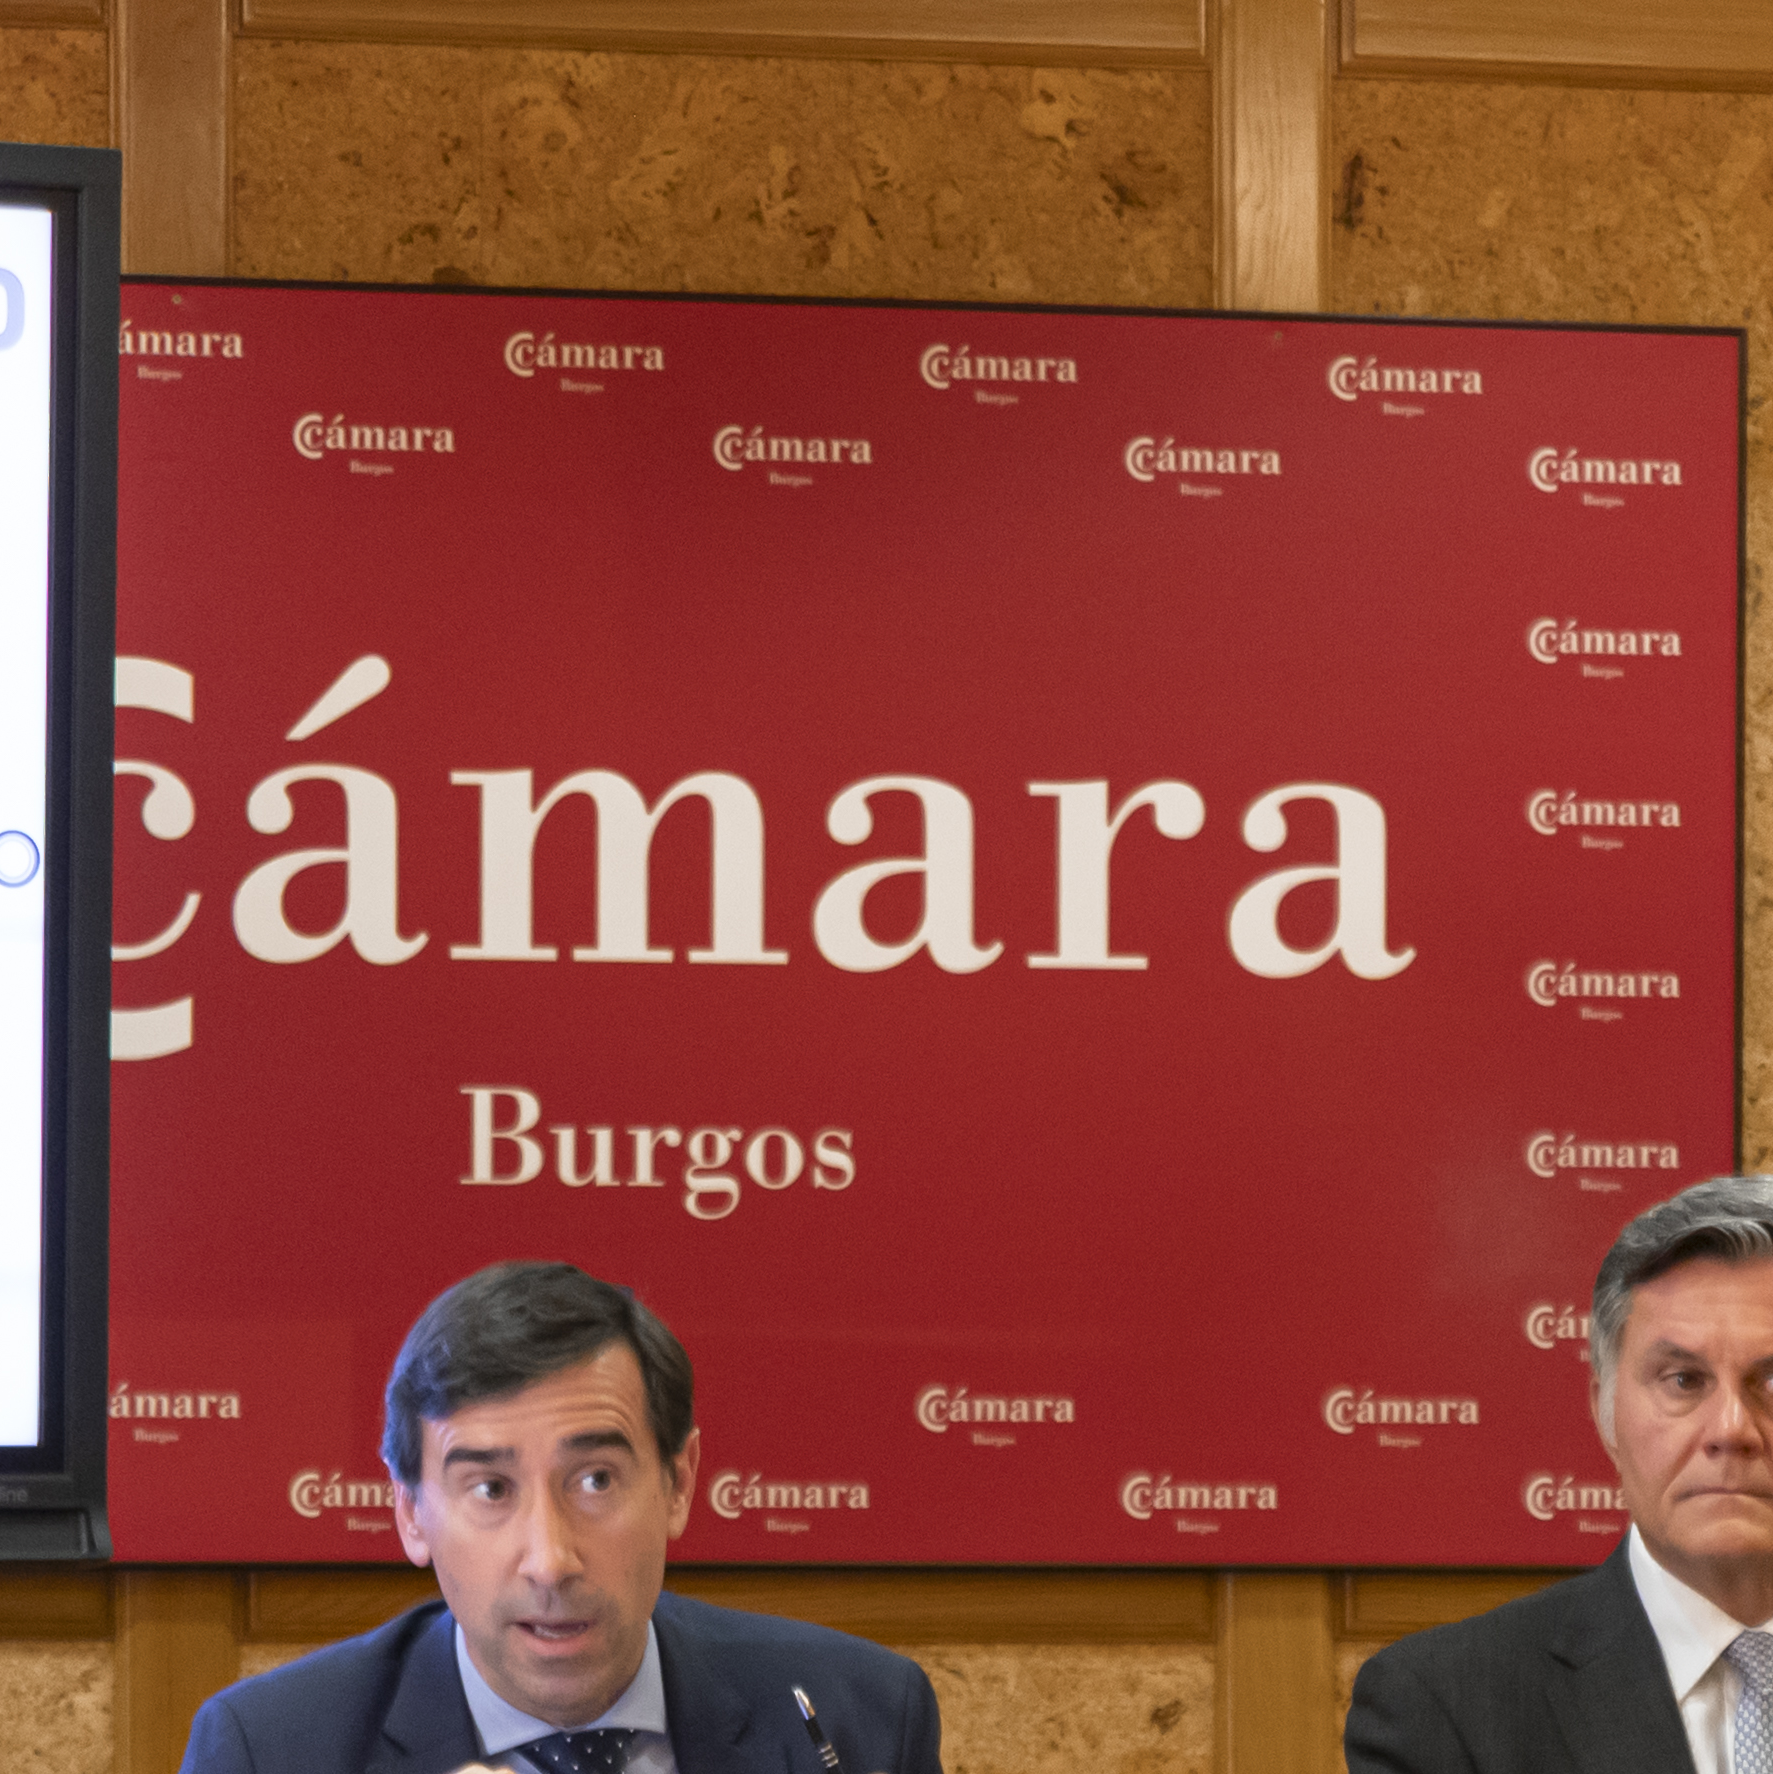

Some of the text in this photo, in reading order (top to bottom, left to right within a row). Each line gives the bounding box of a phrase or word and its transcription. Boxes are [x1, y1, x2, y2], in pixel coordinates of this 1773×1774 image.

[118, 319, 245, 359] ámara
[503, 330, 665, 377] Cámara
[920, 343, 1080, 390] Cámara
[1327, 354, 1484, 401] Cámara
[292, 412, 456, 460] Cámara
[713, 423, 873, 471] Cámara
[1124, 435, 1282, 481] Cámara
[1529, 446, 1683, 492] Cámara
[1528, 618, 1682, 664] Cámara
[1528, 788, 1682, 835] Cámara
[1526, 960, 1680, 1007] Cámara
[461, 1086, 855, 1220] Burgos
[1526, 1131, 1680, 1178] Cámara
[109, 1384, 242, 1421] ámara
[916, 1386, 1076, 1434] Cámara
[1324, 1389, 1481, 1436] Cámara
[288, 1471, 396, 1519] Cáma
[709, 1472, 871, 1520] Cámara
[1120, 1474, 1278, 1521] Cámara
[1524, 1475, 1627, 1521] Cáma
